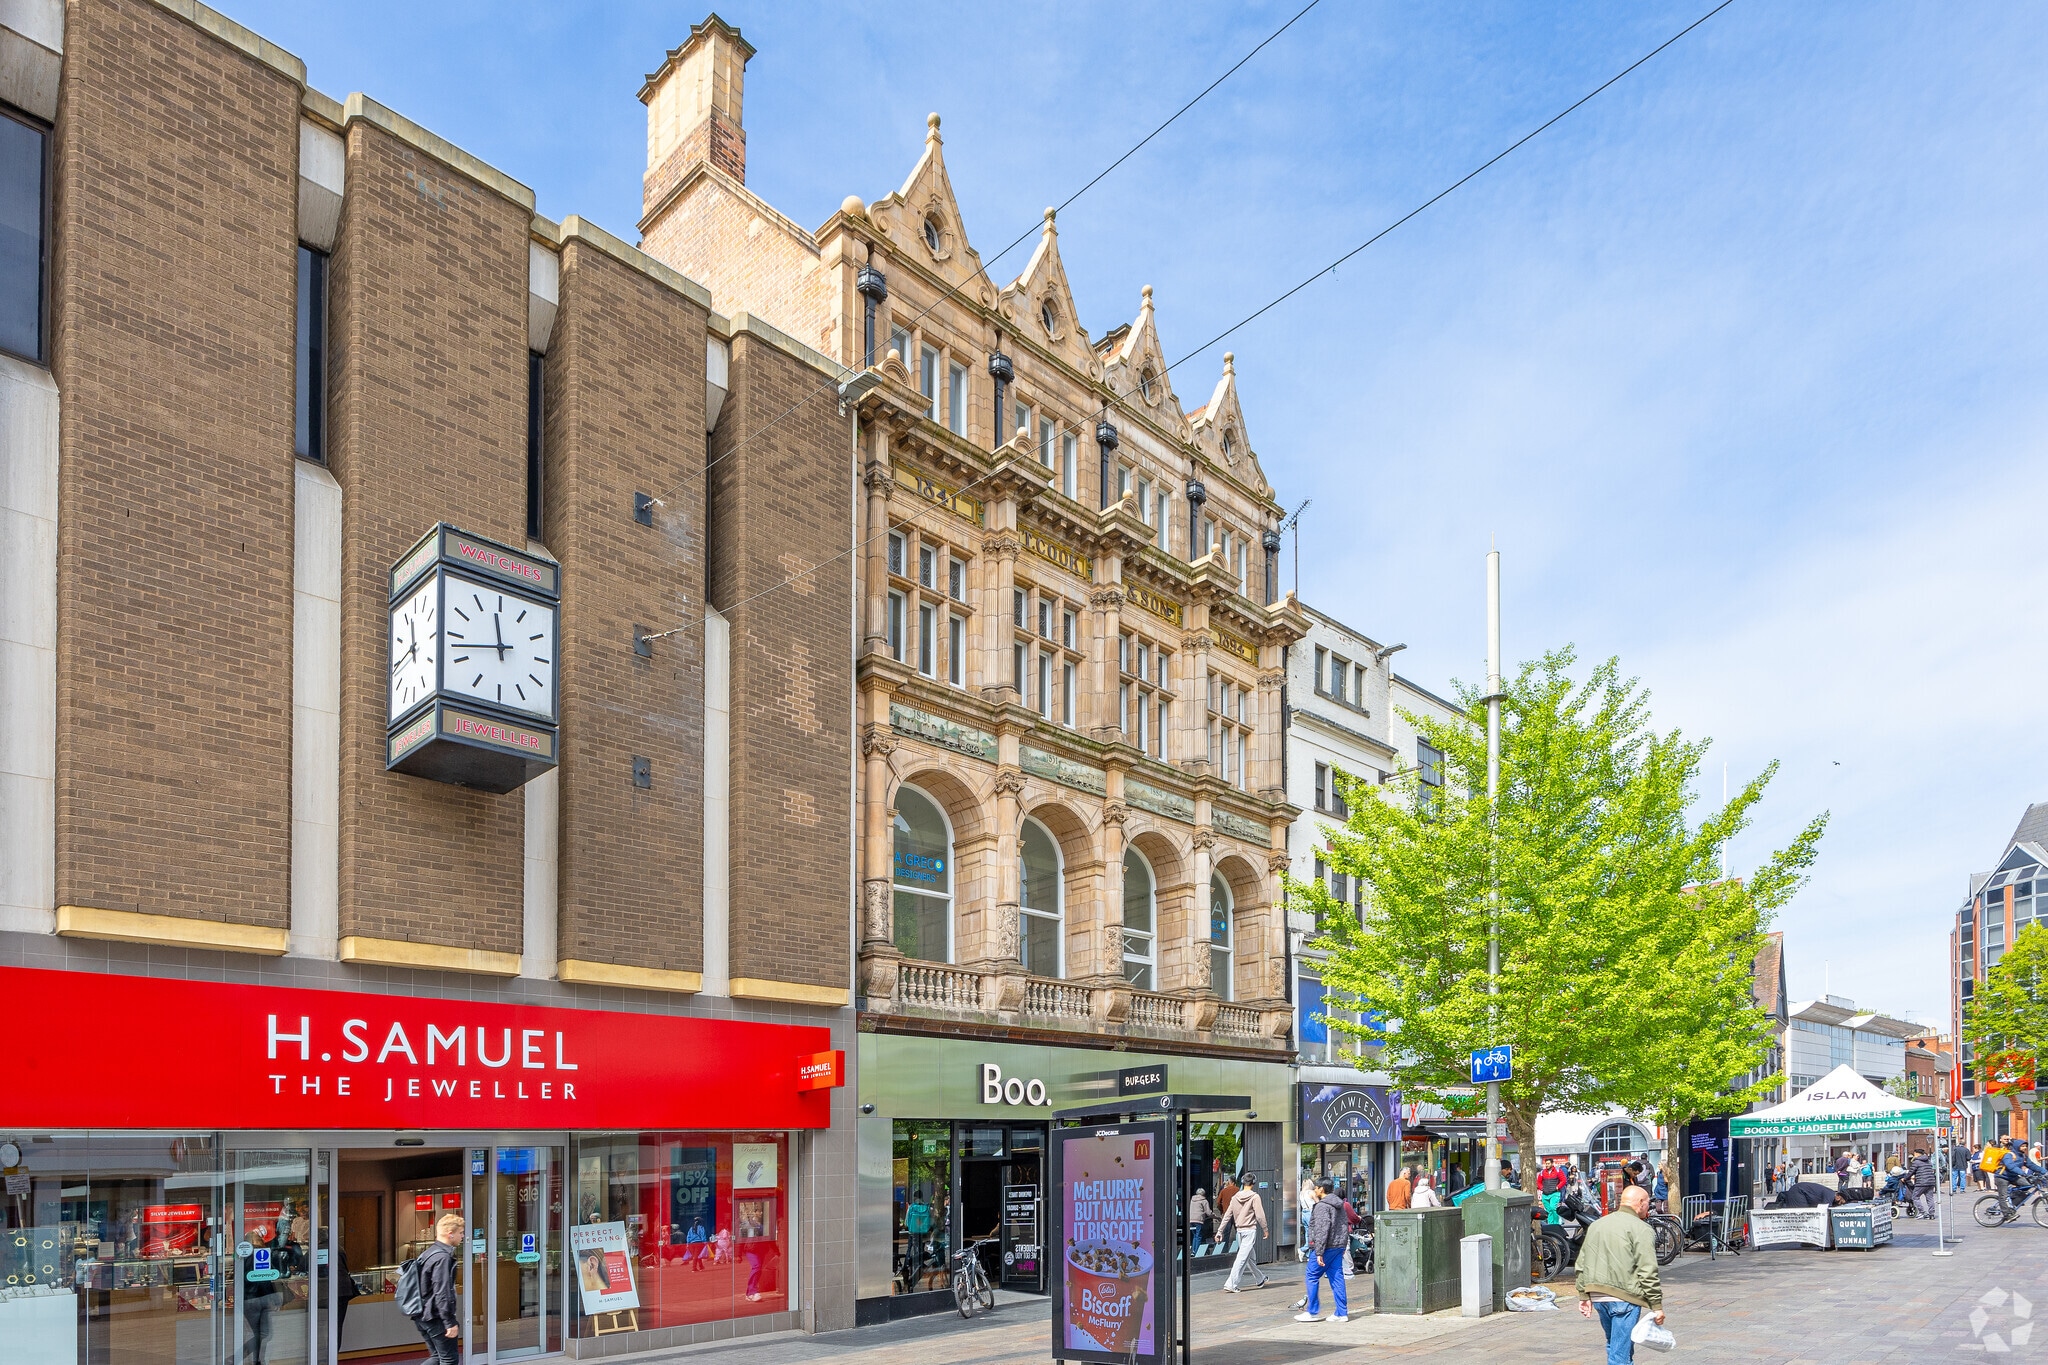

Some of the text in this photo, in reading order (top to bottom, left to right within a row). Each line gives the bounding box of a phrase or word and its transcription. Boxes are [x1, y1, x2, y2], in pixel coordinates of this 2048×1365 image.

[1021, 530, 1080, 572] T.COOK
[397, 542, 435, 586] H.SAMUEL
[458, 541, 542, 582] WATCHES
[1126, 583, 1138, 601] &
[395, 718, 432, 757] JEWELLER
[455, 718, 540, 749] JEWELLER
[895, 867, 937, 883] DESIGNERS
[267, 1013, 579, 1070] H.SAMUEL
[801, 1062, 831, 1075] H.SAMUEL
[268, 1074, 577, 1102] THE JEWELLER
[983, 1063, 1052, 1107] Boo.
[1124, 1073, 1161, 1087] BURGERS
[1807, 1090, 1867, 1101] ISLAM
[1327, 1096, 1381, 1125] FLAWLESS
[1760, 1109, 1902, 1124] FREE QUR'AN IN ENGLISH &
[1744, 1119, 1921, 1134] BOOKS OF HADEETH AND SUNNAH
[678, 1170, 709, 1187] 15%
[519, 1185, 539, 1202] sale
[676, 1187, 709, 1204] OFF
[1073, 1179, 1144, 1201] McFLURRY
[1074, 1199, 1143, 1221] BUT MAKE
[573, 1228, 613, 1238] PERFECT
[1073, 1220, 1144, 1241] IT BISCOFF
[574, 1235, 623, 1245] PIERCING.
[1838, 1237, 1867, 1245] SUNNAH
[1082, 1288, 1132, 1317] Biscoff
[1088, 1315, 1122, 1331] McFlurry
